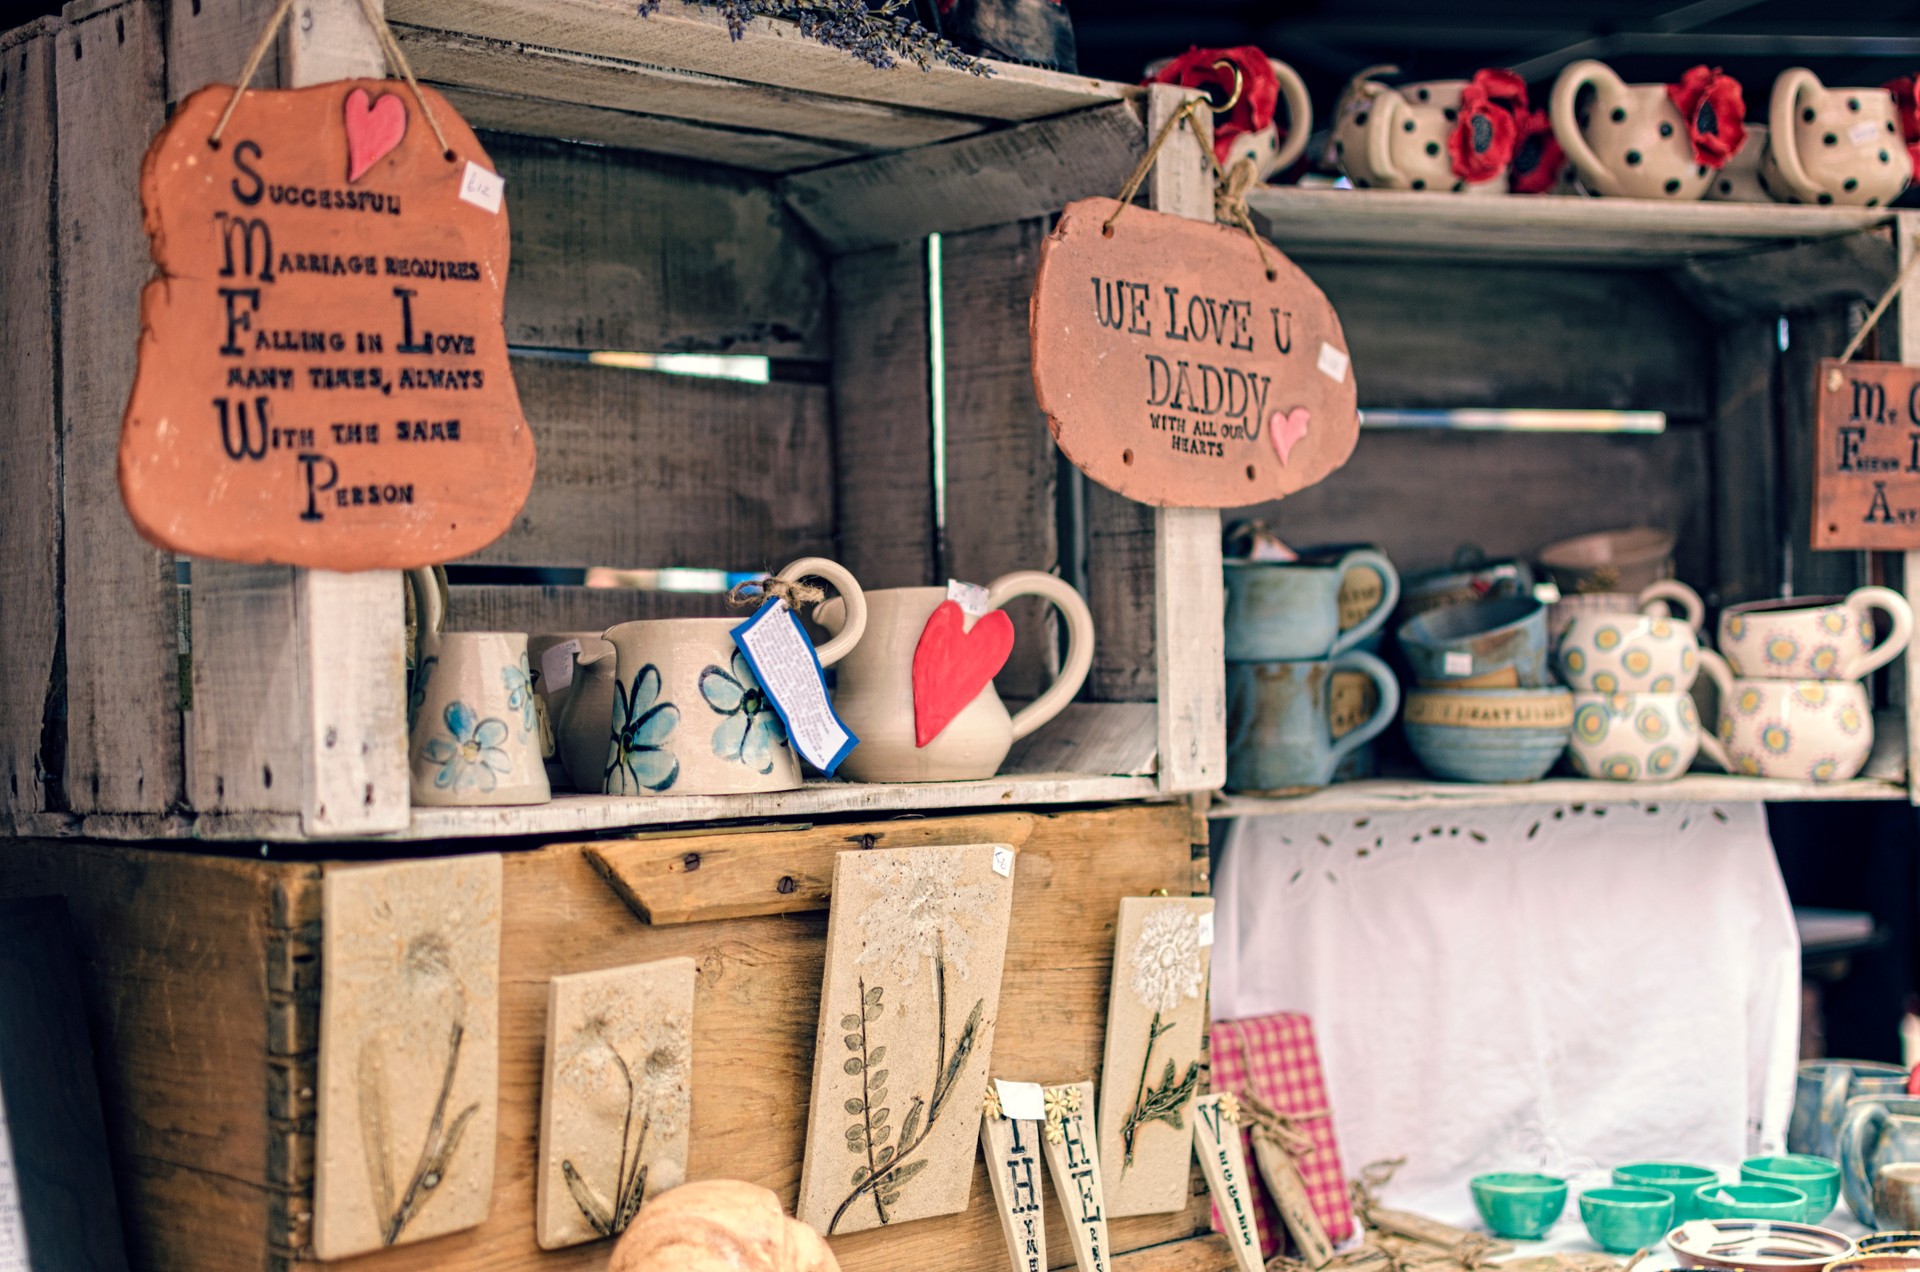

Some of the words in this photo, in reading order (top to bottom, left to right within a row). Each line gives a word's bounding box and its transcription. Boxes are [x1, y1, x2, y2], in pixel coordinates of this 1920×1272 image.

[231, 139, 401, 215] SUCCESSFUL
[214, 211, 377, 284] MARRIAGE
[385, 256, 482, 282] REQUIRES
[217, 287, 346, 357] FALLING
[355, 331, 384, 355] IN
[392, 286, 476, 356] LOVE
[1091, 276, 1151, 336] WE
[1164, 286, 1254, 352] LOVE
[1270, 308, 1292, 355] U
[226, 367, 294, 390] MANY
[399, 367, 484, 390] ALWAYS
[1145, 354, 1271, 442] DADDY
[213, 396, 315, 460] WITH
[330, 422, 380, 445] THE
[395, 419, 462, 442] SAME
[1149, 412, 1186, 434] WITH
[1193, 420, 1218, 437] ALL
[1221, 423, 1245, 440] OUR
[1171, 434, 1224, 457] HEARTS
[296, 453, 415, 522] PERSON
